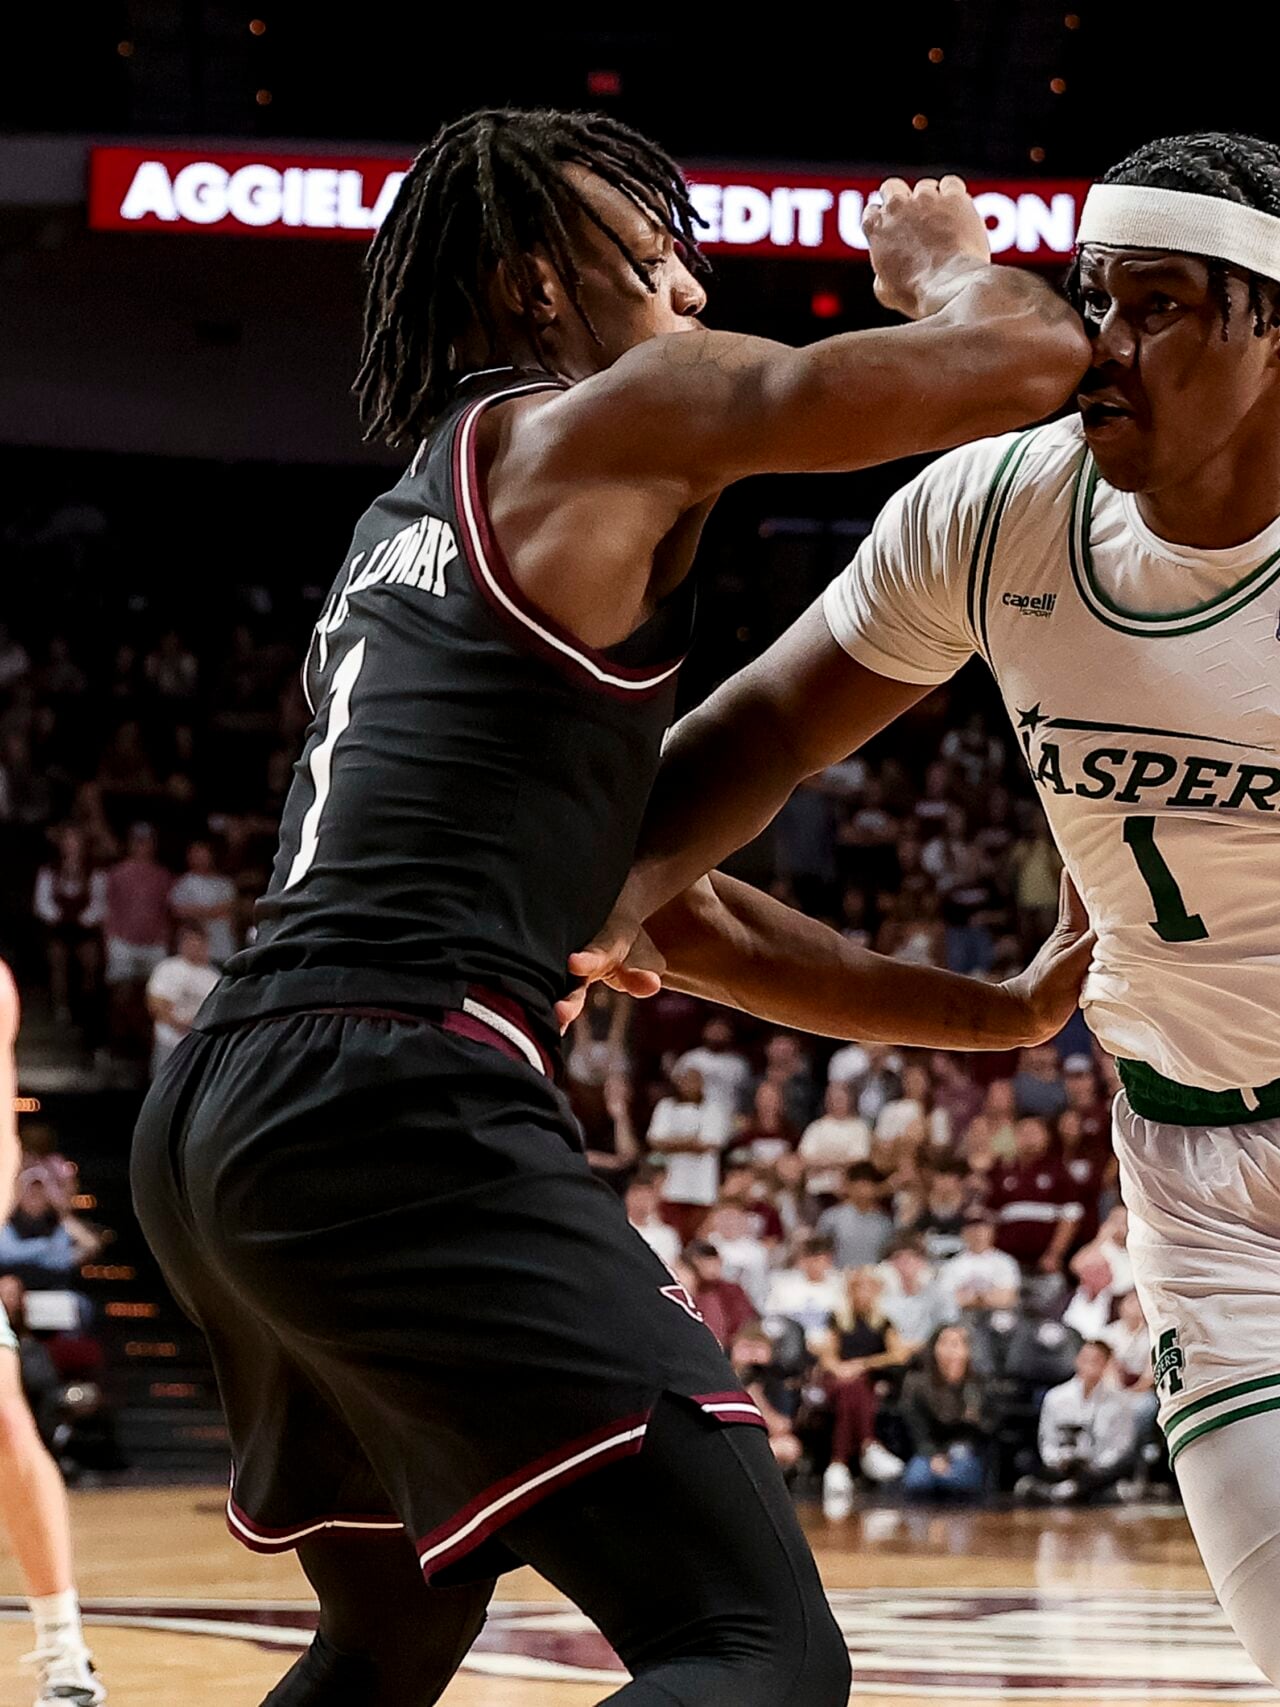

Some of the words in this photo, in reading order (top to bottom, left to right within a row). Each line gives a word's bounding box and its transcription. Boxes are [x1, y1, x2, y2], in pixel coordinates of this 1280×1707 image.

[687, 184, 834, 247] EDIT
[838, 189, 1076, 253] UON
[1002, 592, 1057, 612] capelli
[284, 637, 366, 891] 1
[1123, 815, 1210, 943] 1
